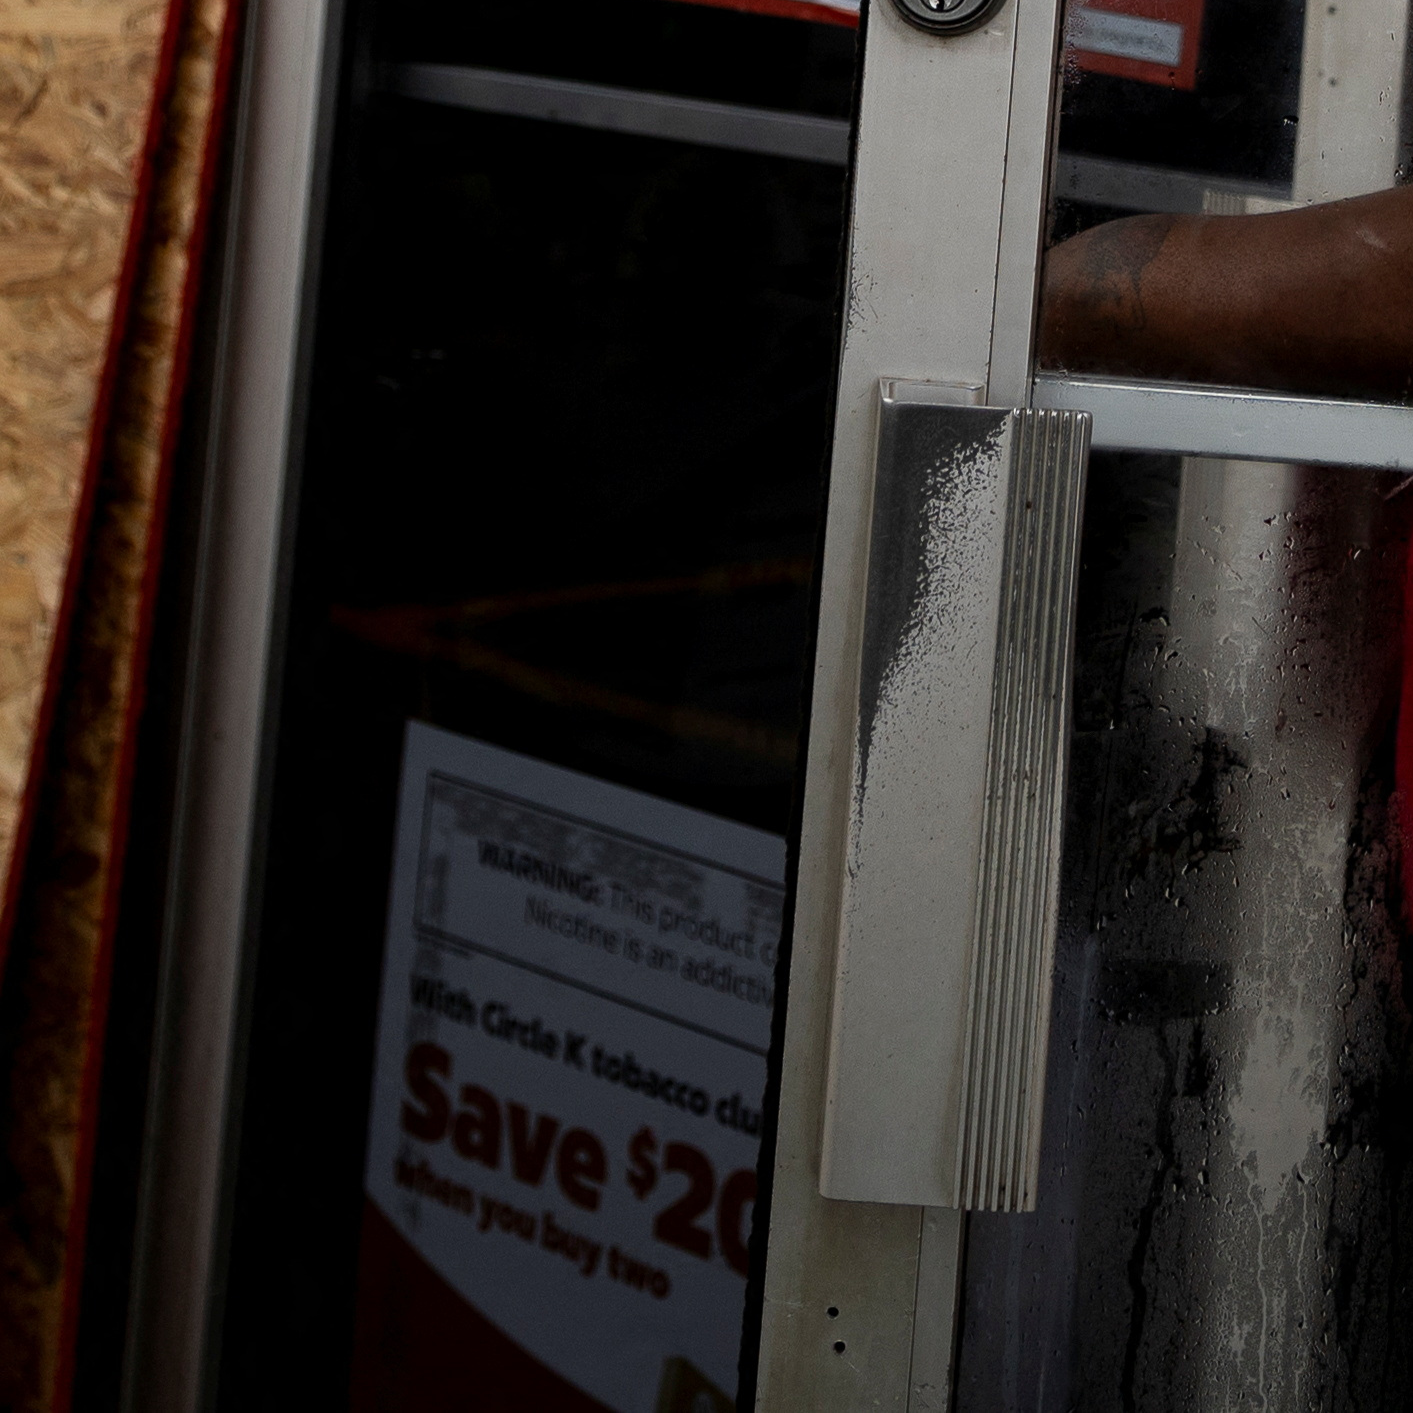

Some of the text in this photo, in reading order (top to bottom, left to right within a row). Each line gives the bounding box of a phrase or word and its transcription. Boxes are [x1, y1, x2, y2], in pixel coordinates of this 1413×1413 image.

[478, 838, 605, 906] WARNING:
[611, 882, 656, 925] This
[658, 904, 756, 961] product
[525, 893, 620, 955] Nicotine
[623, 927, 644, 964] is
[646, 943, 679, 972] an
[401, 1042, 608, 1212] Save
[410, 977, 763, 1137] With Circle K tobacco clu
[396, 1158, 672, 1301] when you buy two
